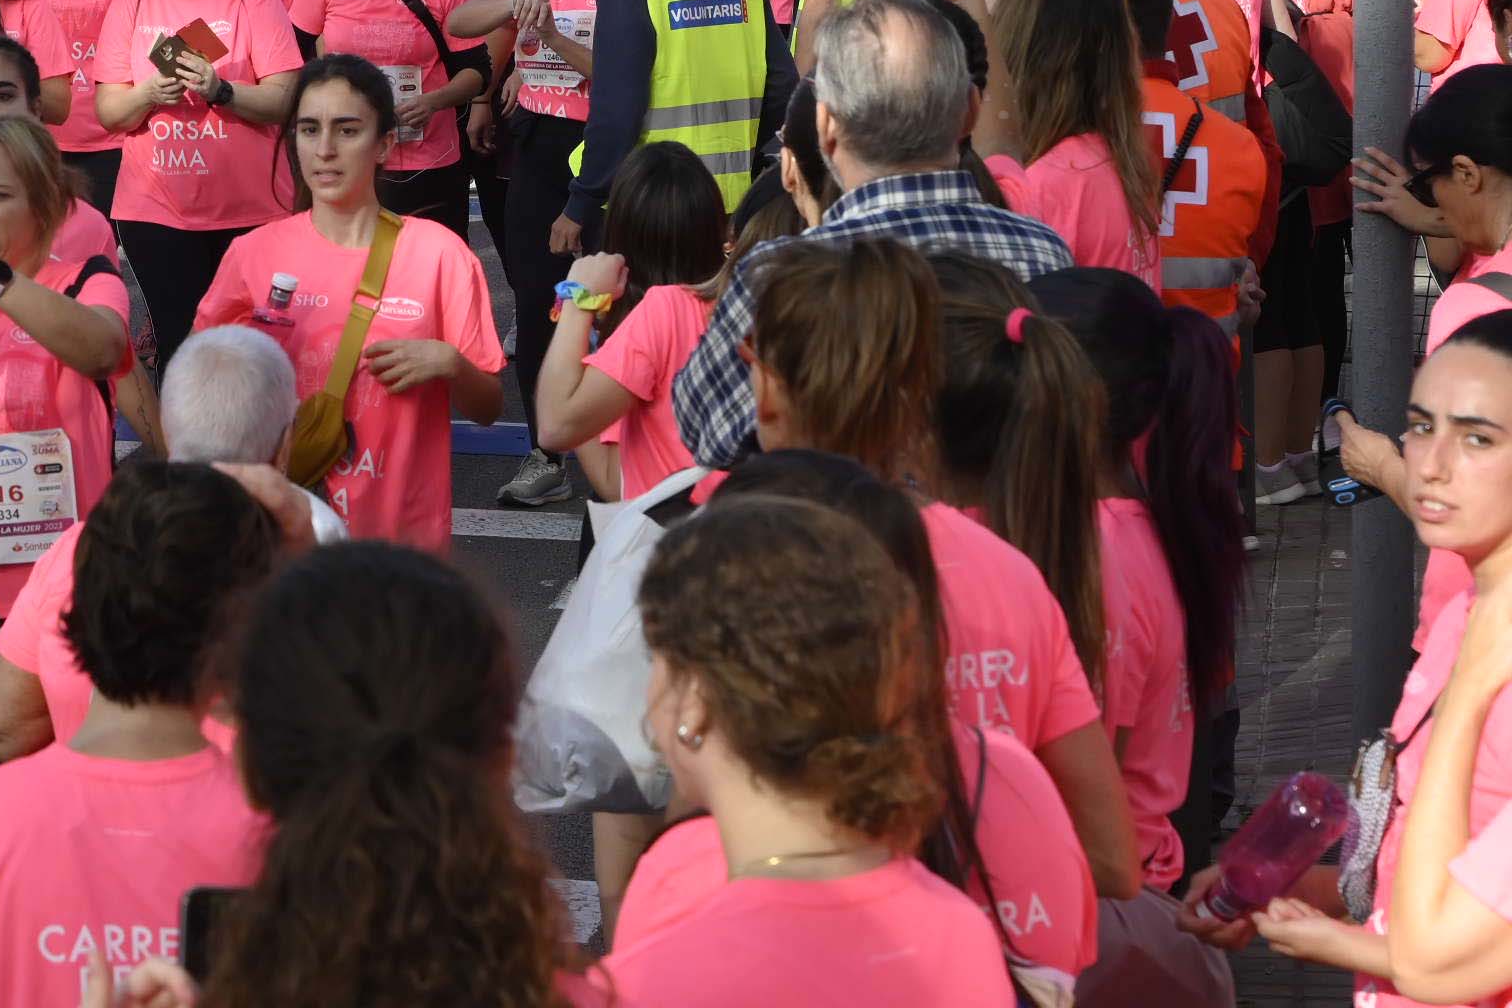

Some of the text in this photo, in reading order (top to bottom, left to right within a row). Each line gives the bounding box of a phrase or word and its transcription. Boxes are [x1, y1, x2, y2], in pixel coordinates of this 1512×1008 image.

[670, 2, 742, 23] VOLUNTARIS
[71, 42, 97, 60] SA
[149, 119, 228, 141] ORSAL
[295, 292, 329, 308] SHO
[0, 527, 12, 535] LA
[13, 525, 42, 533] MUJER
[998, 890, 1053, 936] RA
[38, 924, 181, 963] CARRE
